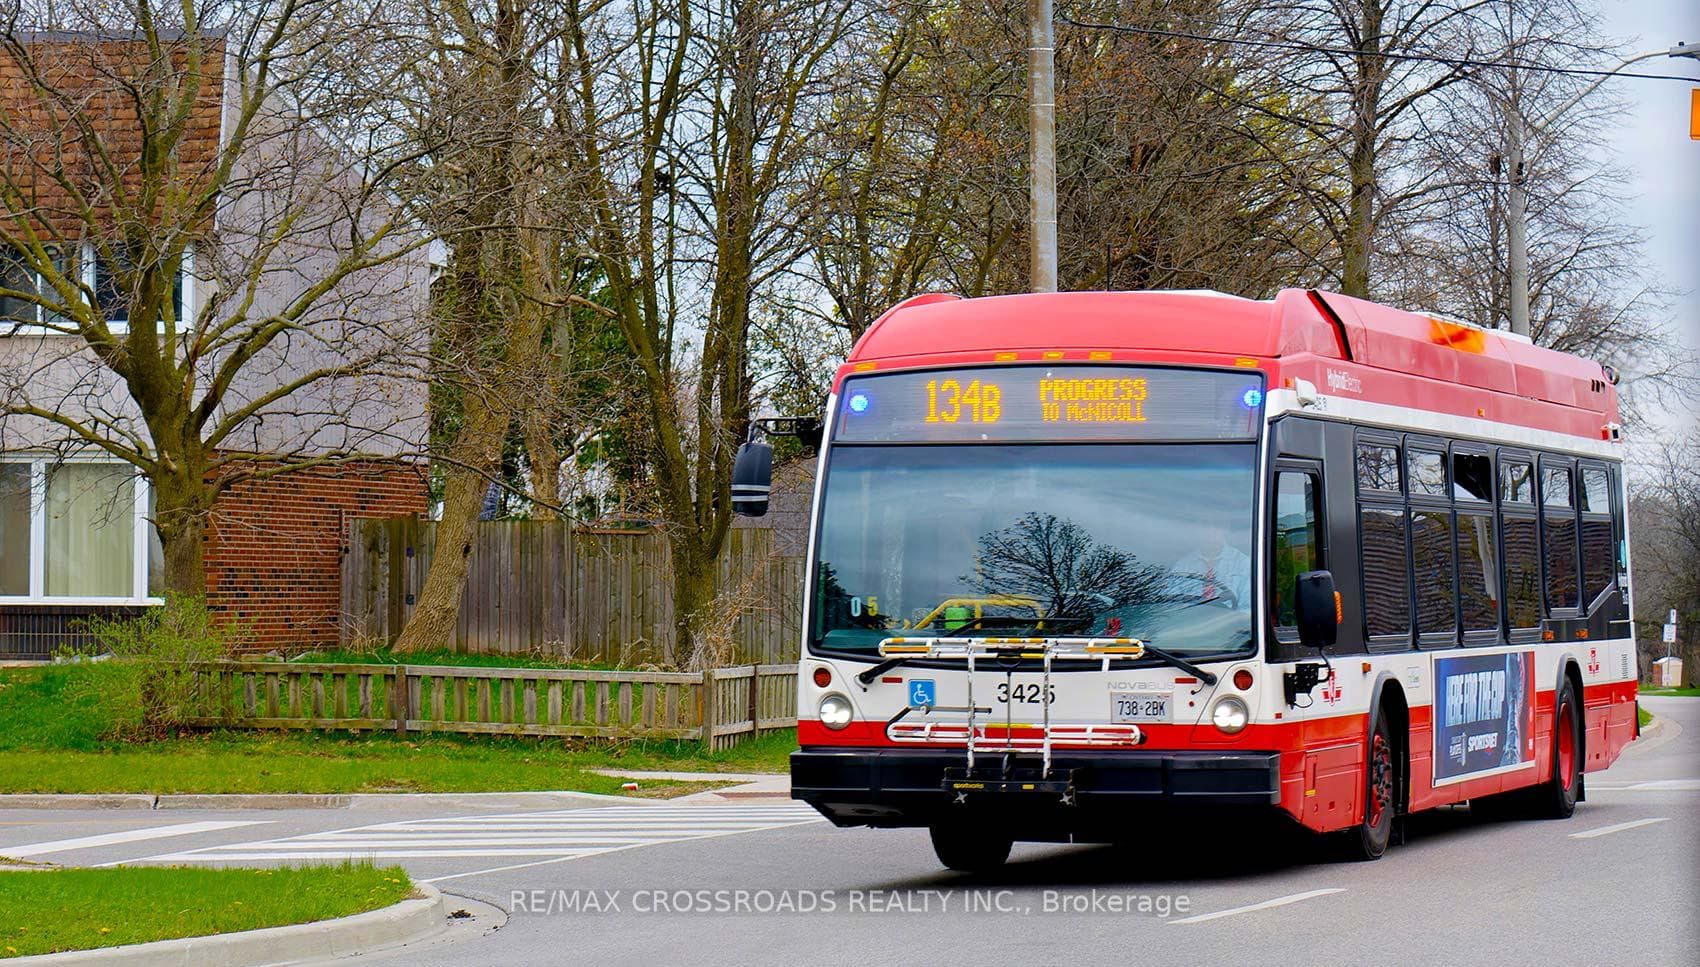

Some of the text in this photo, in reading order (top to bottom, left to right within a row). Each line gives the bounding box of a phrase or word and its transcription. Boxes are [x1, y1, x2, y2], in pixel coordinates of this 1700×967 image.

[924, 379, 1002, 423] 134B
[1039, 379, 1147, 401] PROGRESS
[1041, 402, 1060, 422] TO
[997, 682, 1056, 704] 3425
